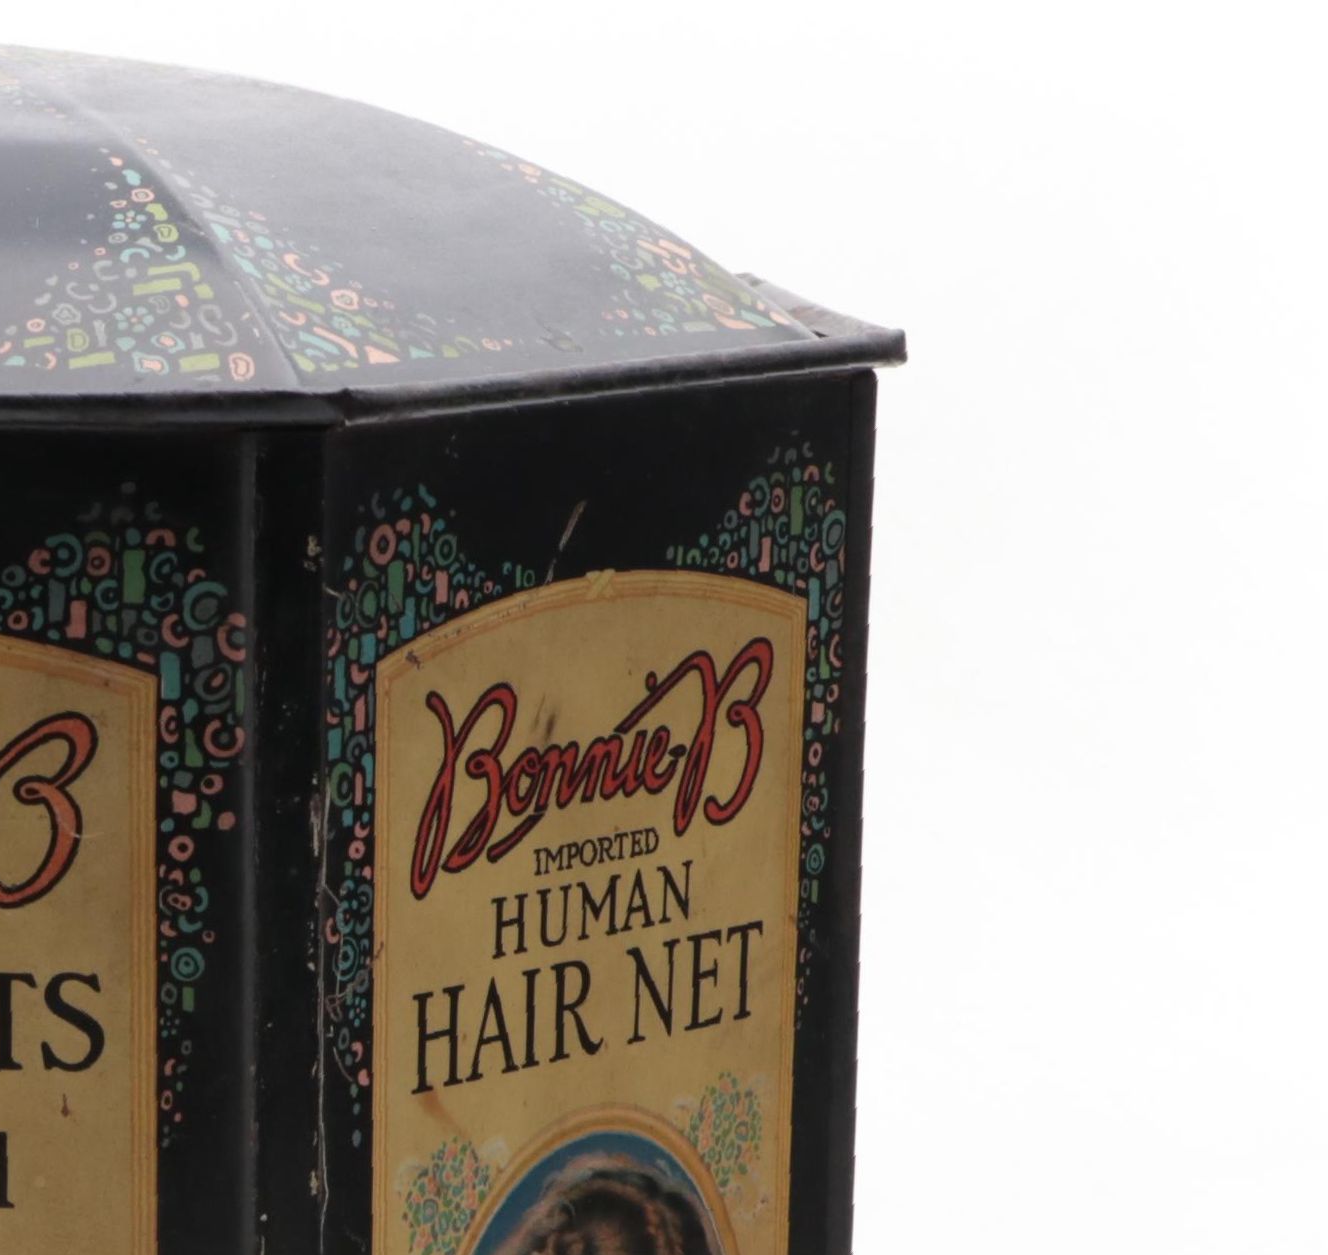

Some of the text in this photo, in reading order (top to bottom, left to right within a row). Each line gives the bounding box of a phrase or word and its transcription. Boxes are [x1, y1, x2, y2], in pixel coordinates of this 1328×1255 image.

[534, 828, 659, 875] IMPORTED
[491, 860, 693, 959] HUMAN
[412, 921, 763, 1094] HAIR NET
